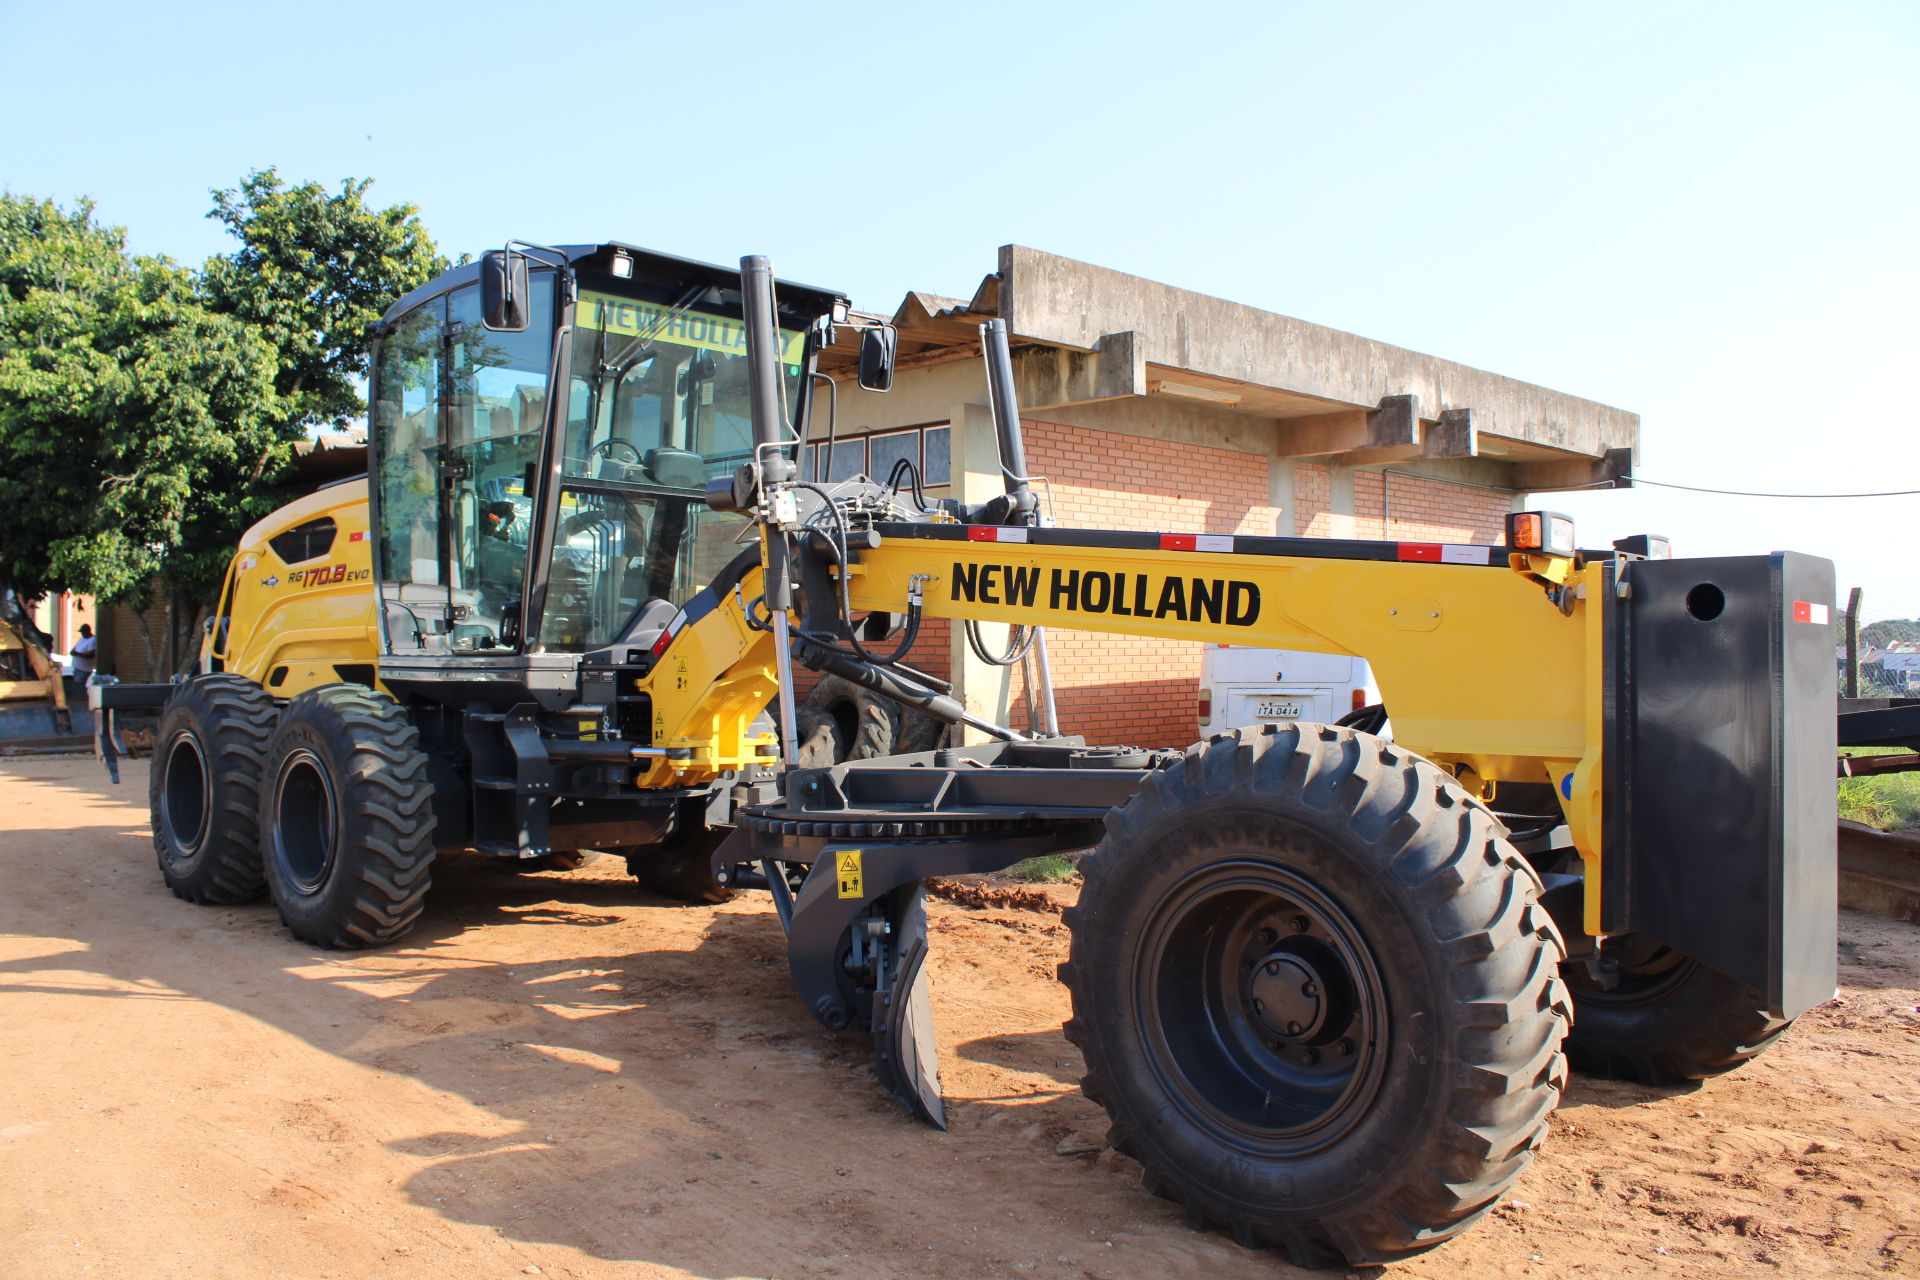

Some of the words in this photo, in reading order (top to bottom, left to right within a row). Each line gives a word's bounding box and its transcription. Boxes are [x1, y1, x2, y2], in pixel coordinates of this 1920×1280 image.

[593, 297, 662, 333] NEW
[347, 569, 369, 582] EVO
[951, 562, 1041, 607] NEW
[1050, 568, 1261, 627] HOLLAND
